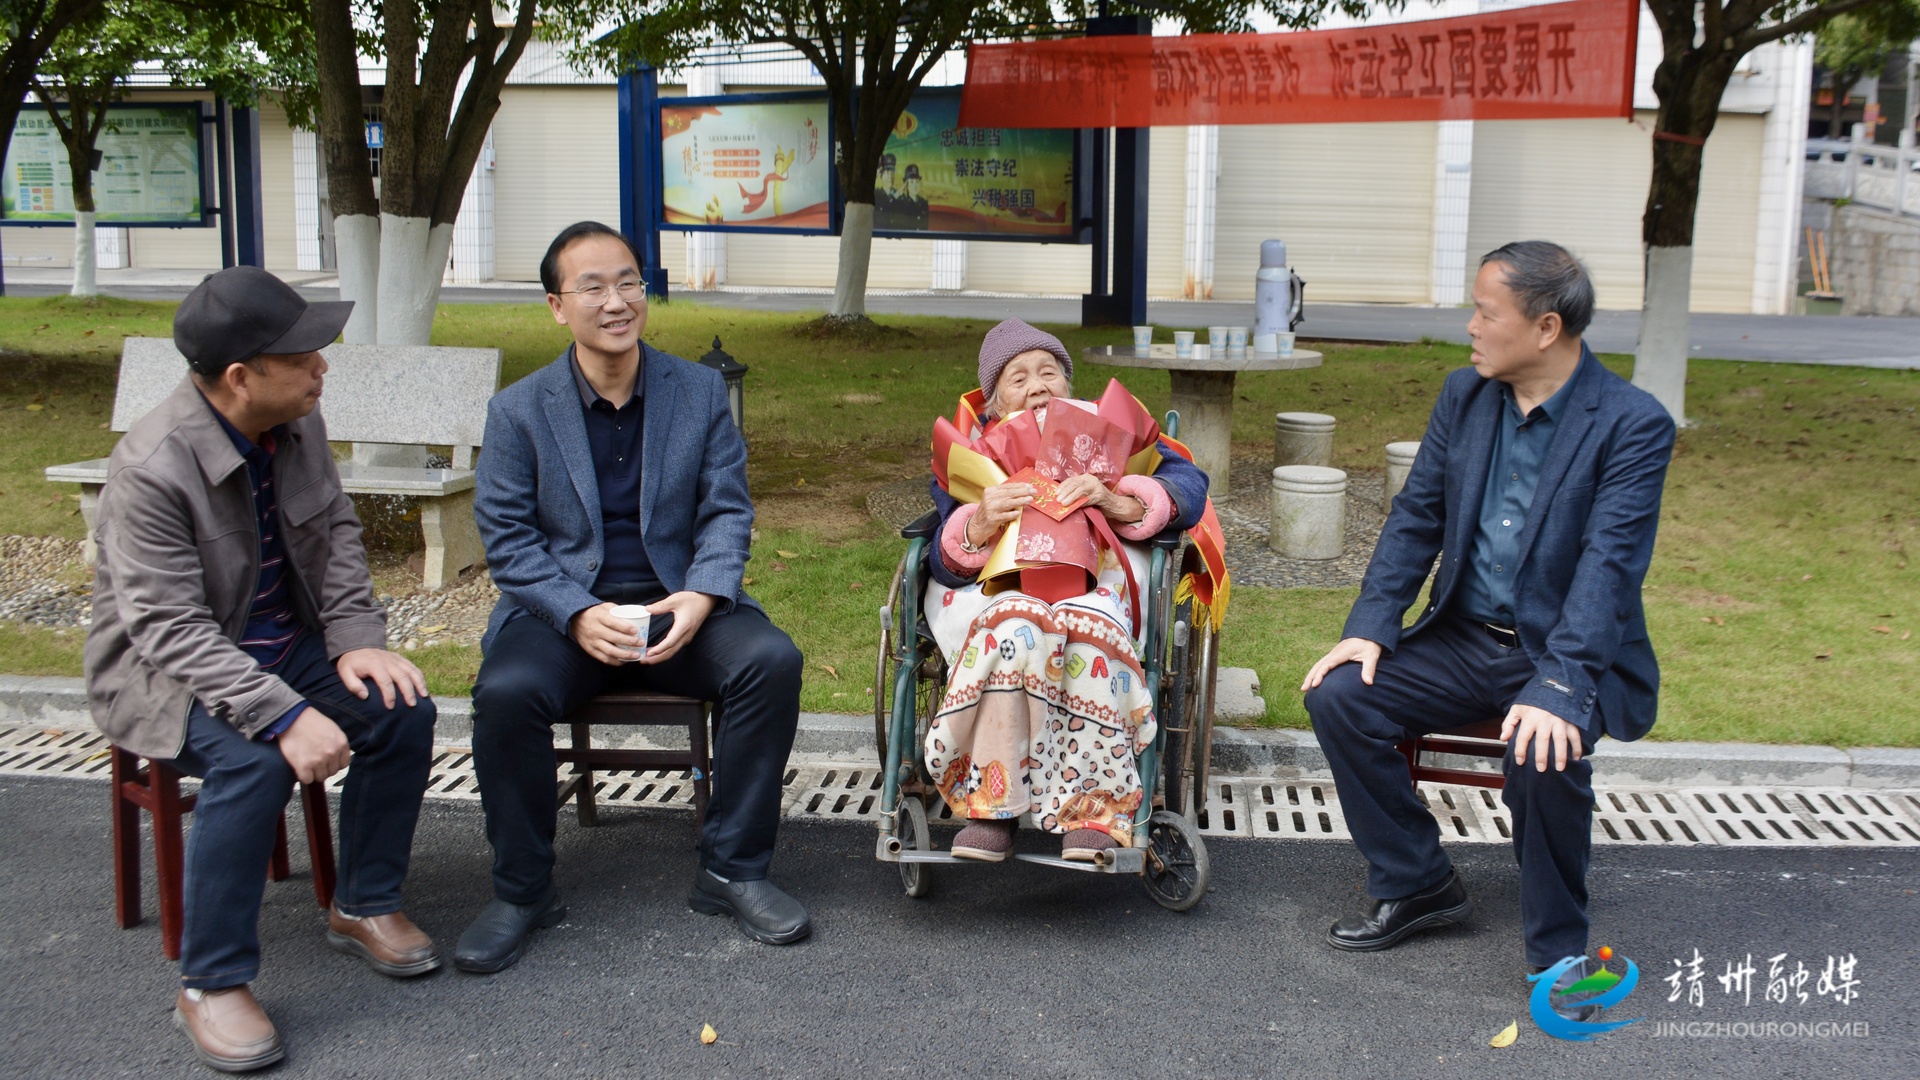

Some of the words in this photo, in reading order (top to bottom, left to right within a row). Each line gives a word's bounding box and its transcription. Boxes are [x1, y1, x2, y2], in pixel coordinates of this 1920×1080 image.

[940, 128, 1001, 147] 忠诚担当
[955, 158, 1017, 178] 崇法守纪
[972, 189, 1035, 209] 兴税强国
